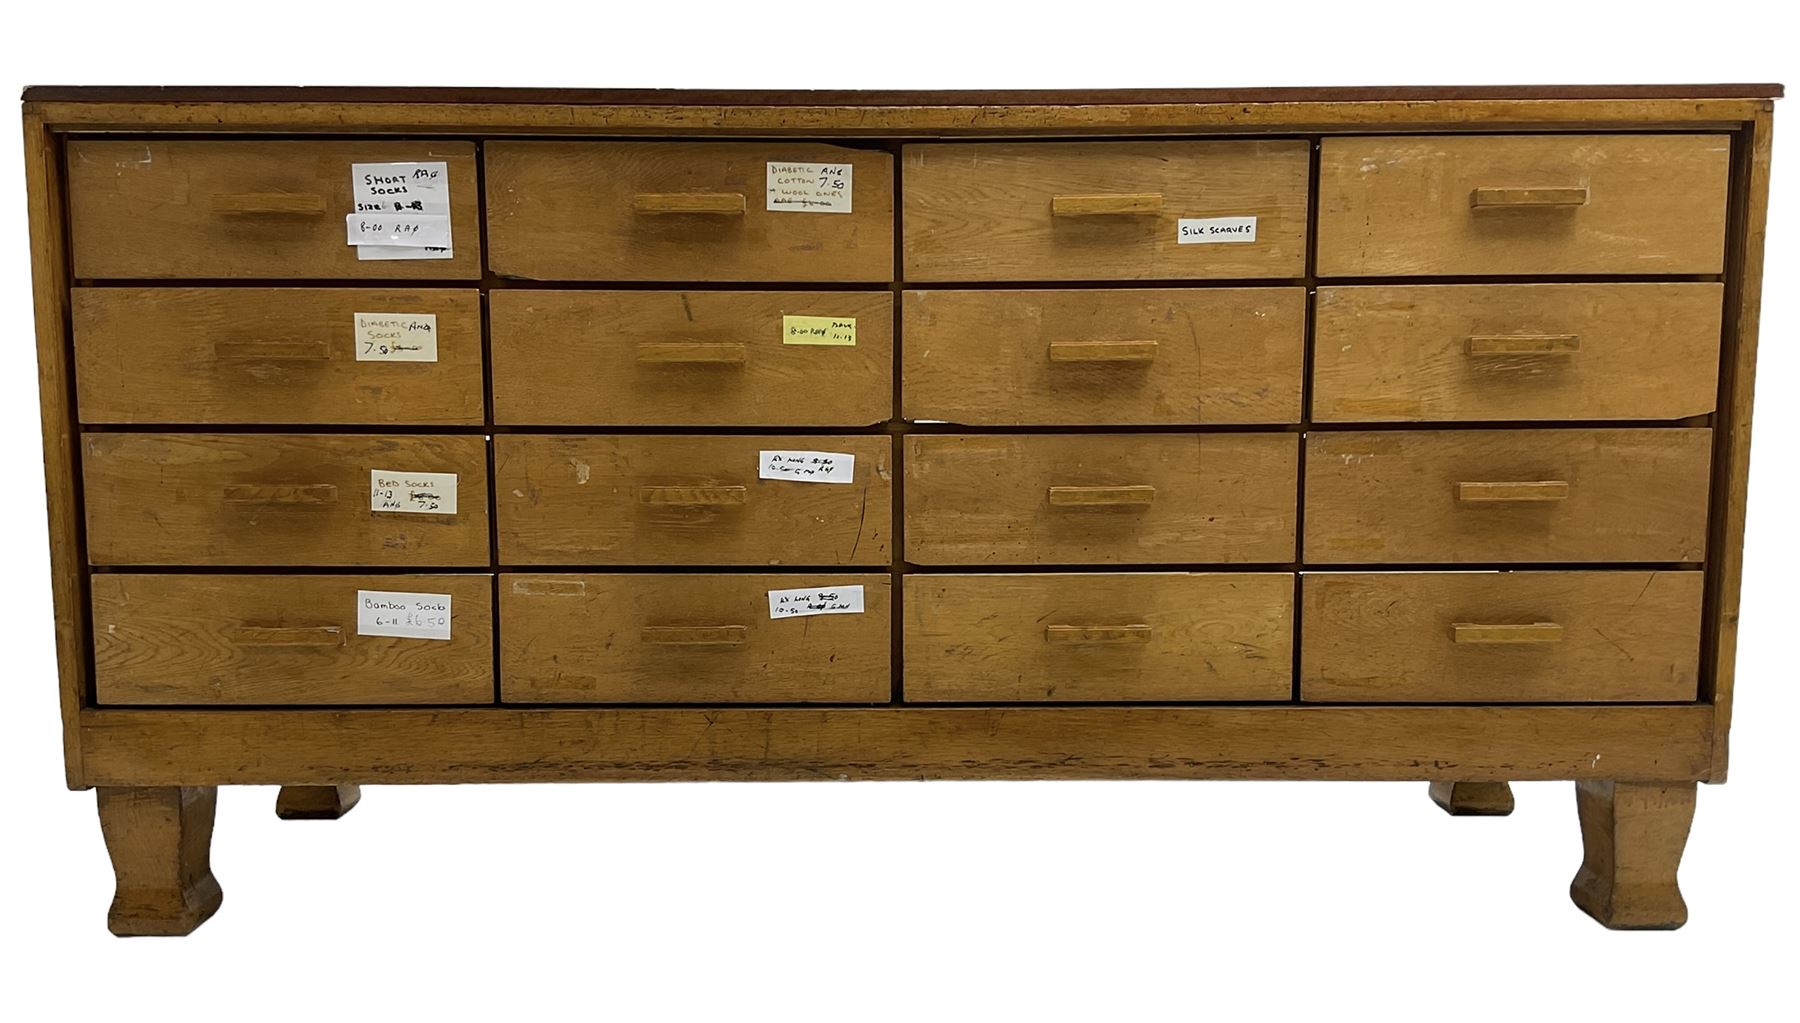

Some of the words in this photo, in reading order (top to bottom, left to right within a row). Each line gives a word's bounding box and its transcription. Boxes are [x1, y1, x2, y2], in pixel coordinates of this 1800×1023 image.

[771, 165, 814, 174] DIABETIC
[364, 174, 406, 185] SHORT
[370, 185, 408, 195] SOCKS
[1181, 226, 1204, 236] SILK
[1209, 225, 1252, 234] SCARVES
[360, 318, 408, 329] DIABETIC
[367, 330, 402, 340] SOCKS
[404, 479, 434, 488] SOCKS
[365, 598, 406, 610] Bamboo
[415, 602, 446, 611] Socks
